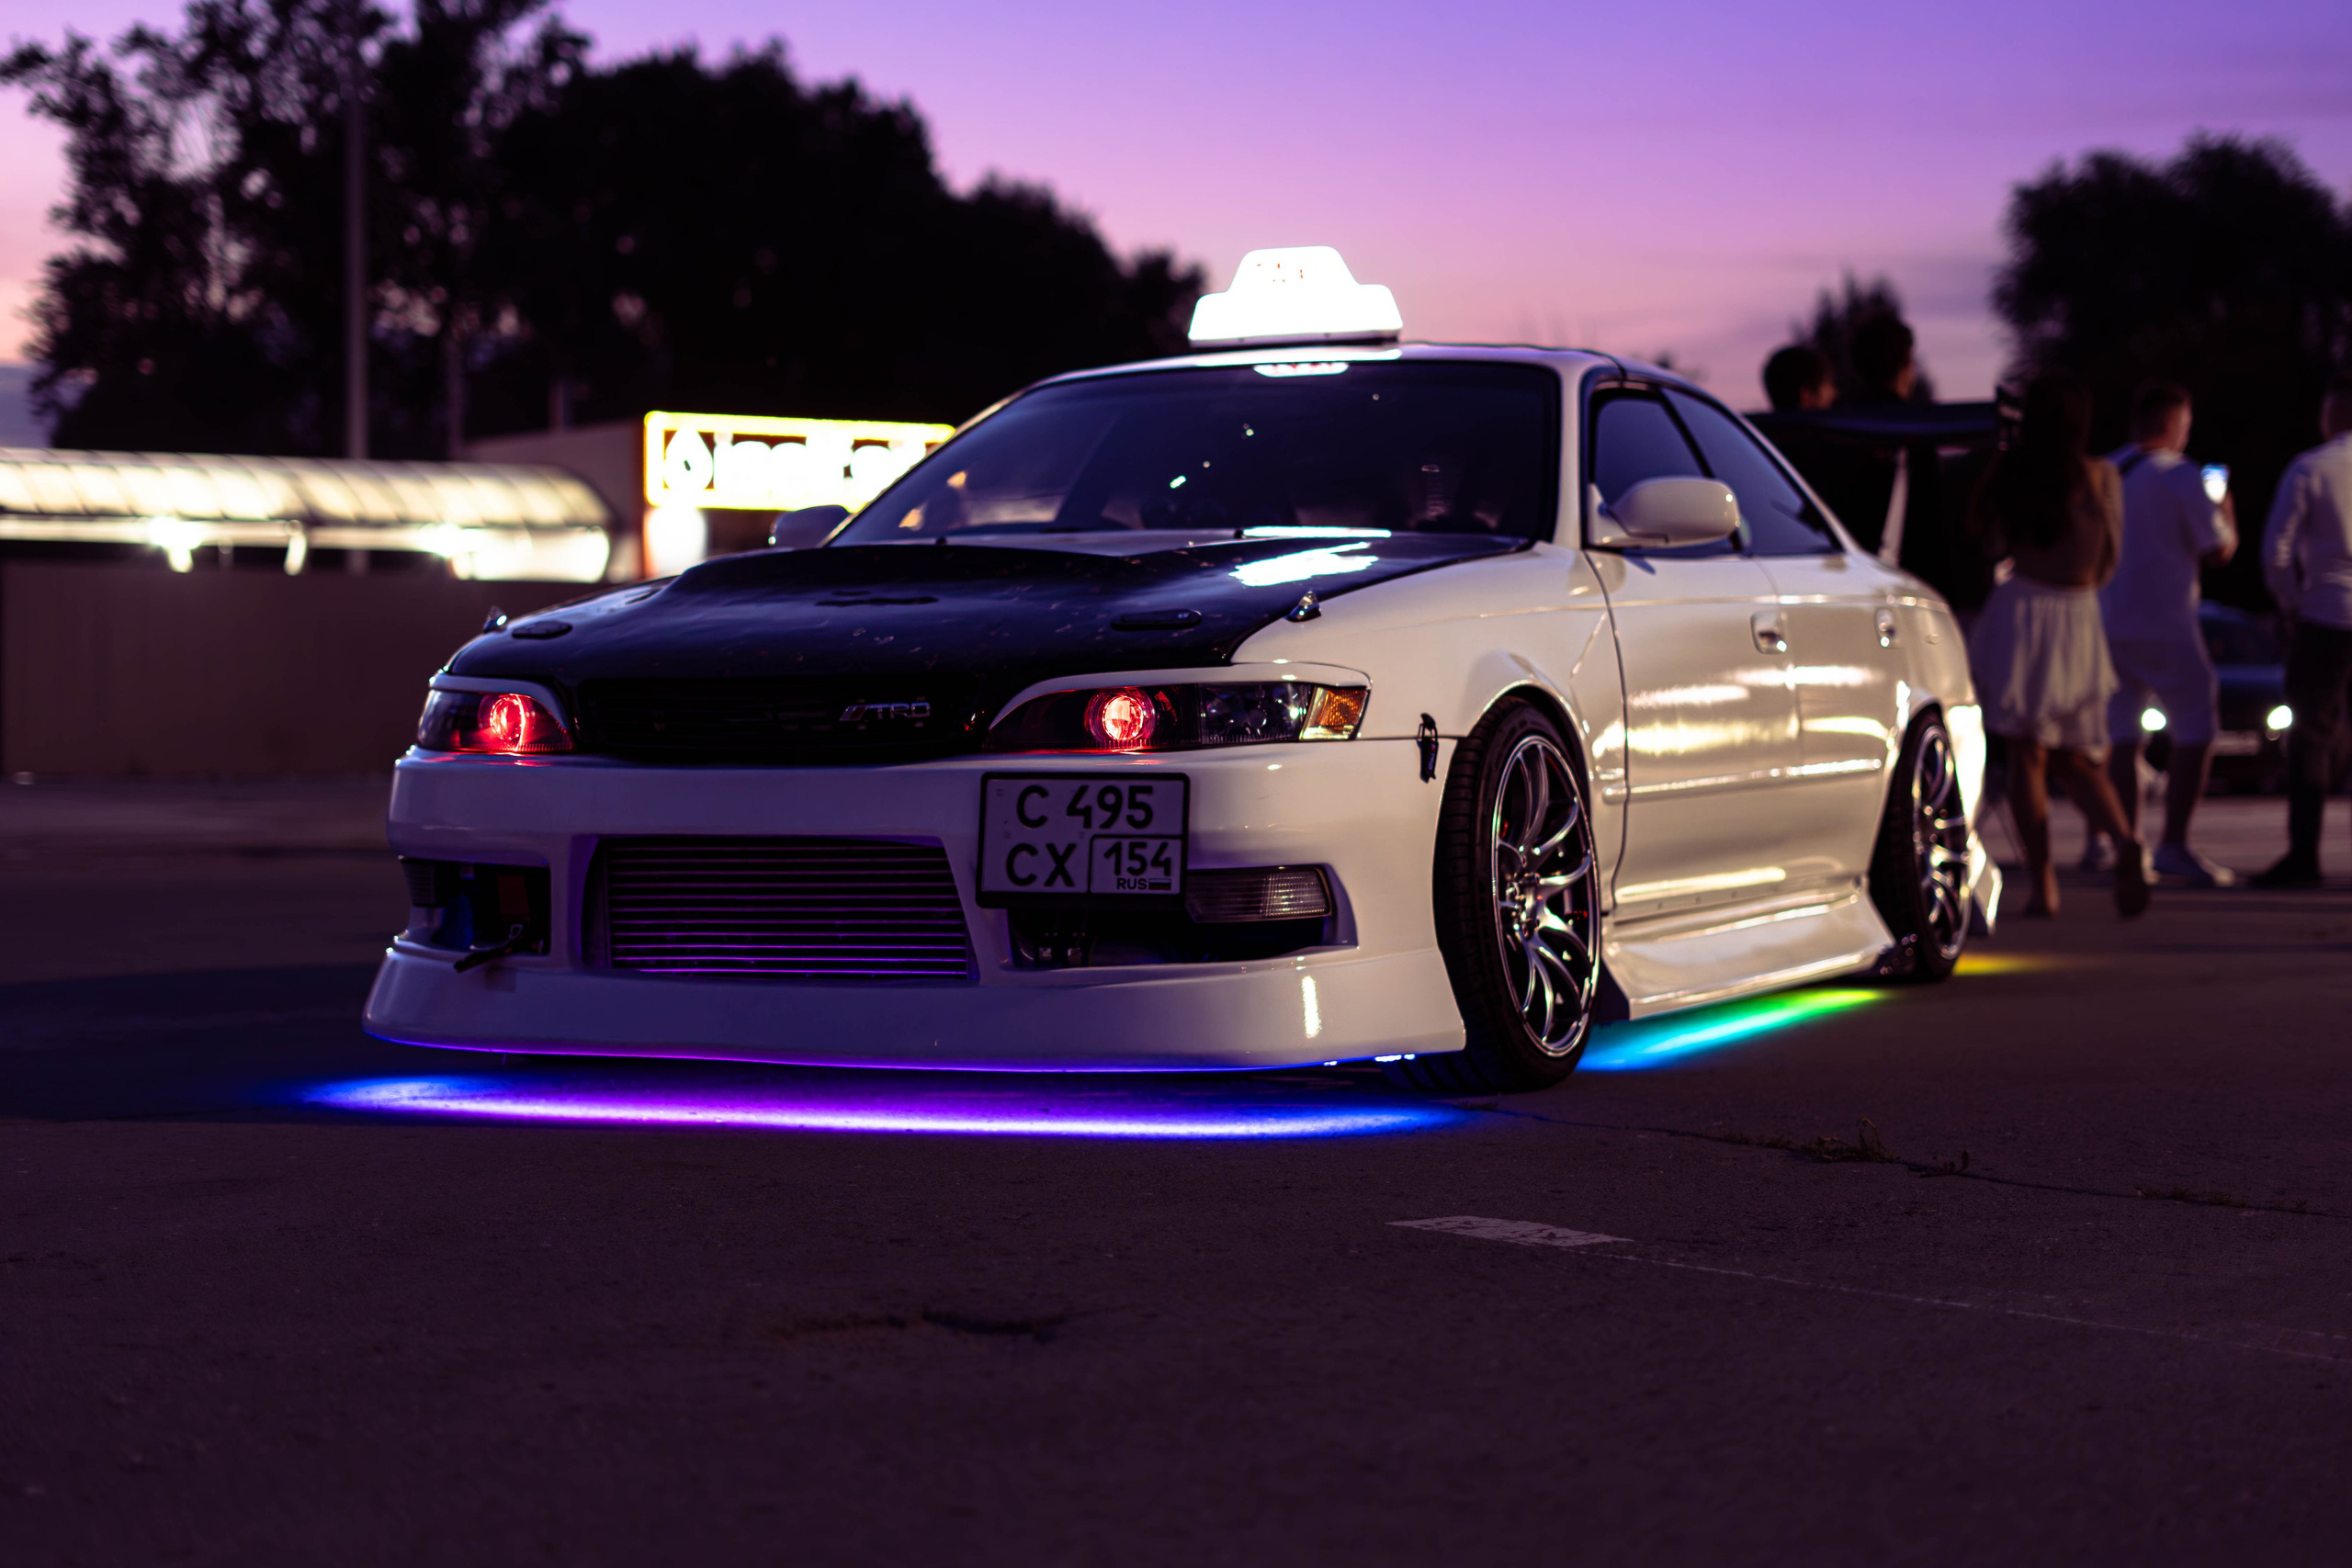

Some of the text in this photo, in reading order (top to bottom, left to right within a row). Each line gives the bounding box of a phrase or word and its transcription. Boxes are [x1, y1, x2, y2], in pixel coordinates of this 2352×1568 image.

[1016, 784, 1154, 829] C 495
[1005, 843, 1077, 887] CX
[1103, 841, 1172, 876] 154
[1116, 878, 1148, 890] RUS
